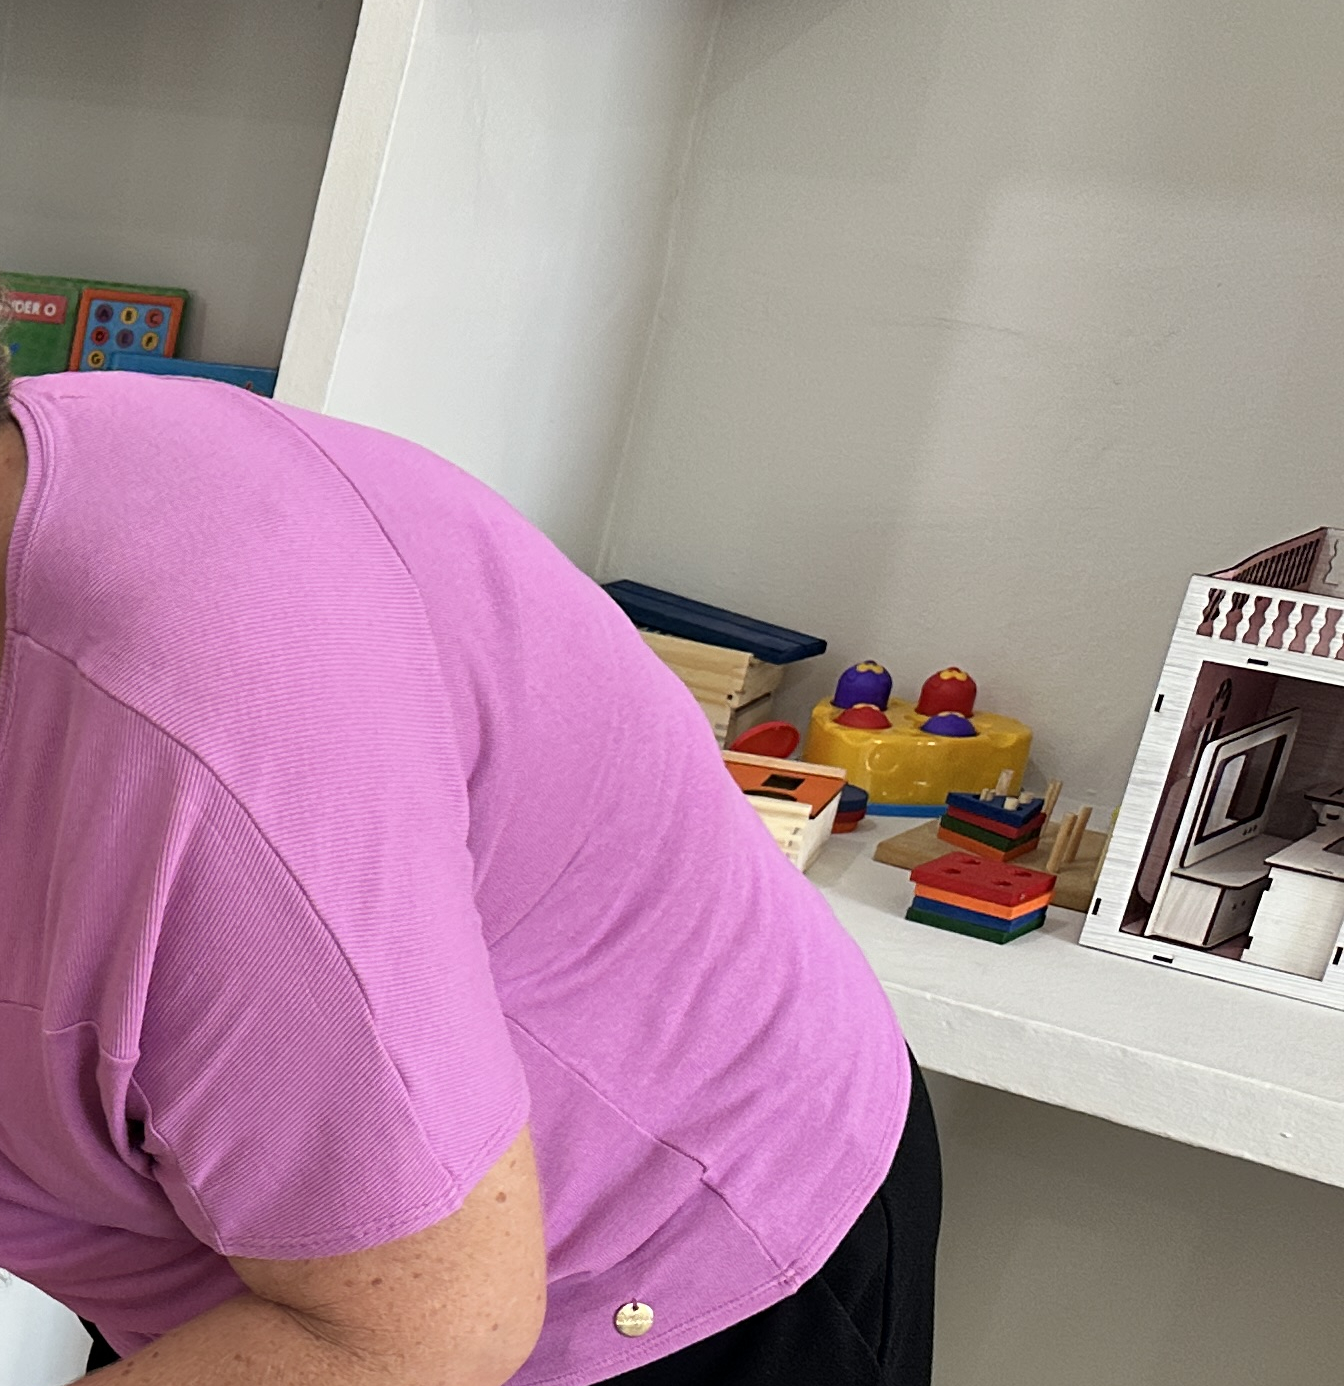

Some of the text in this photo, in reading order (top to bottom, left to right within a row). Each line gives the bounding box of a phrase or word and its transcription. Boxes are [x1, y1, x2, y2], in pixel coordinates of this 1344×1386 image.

[43, 302, 57, 317] O
[150, 312, 159, 325] C
[90, 352, 101, 365] G
